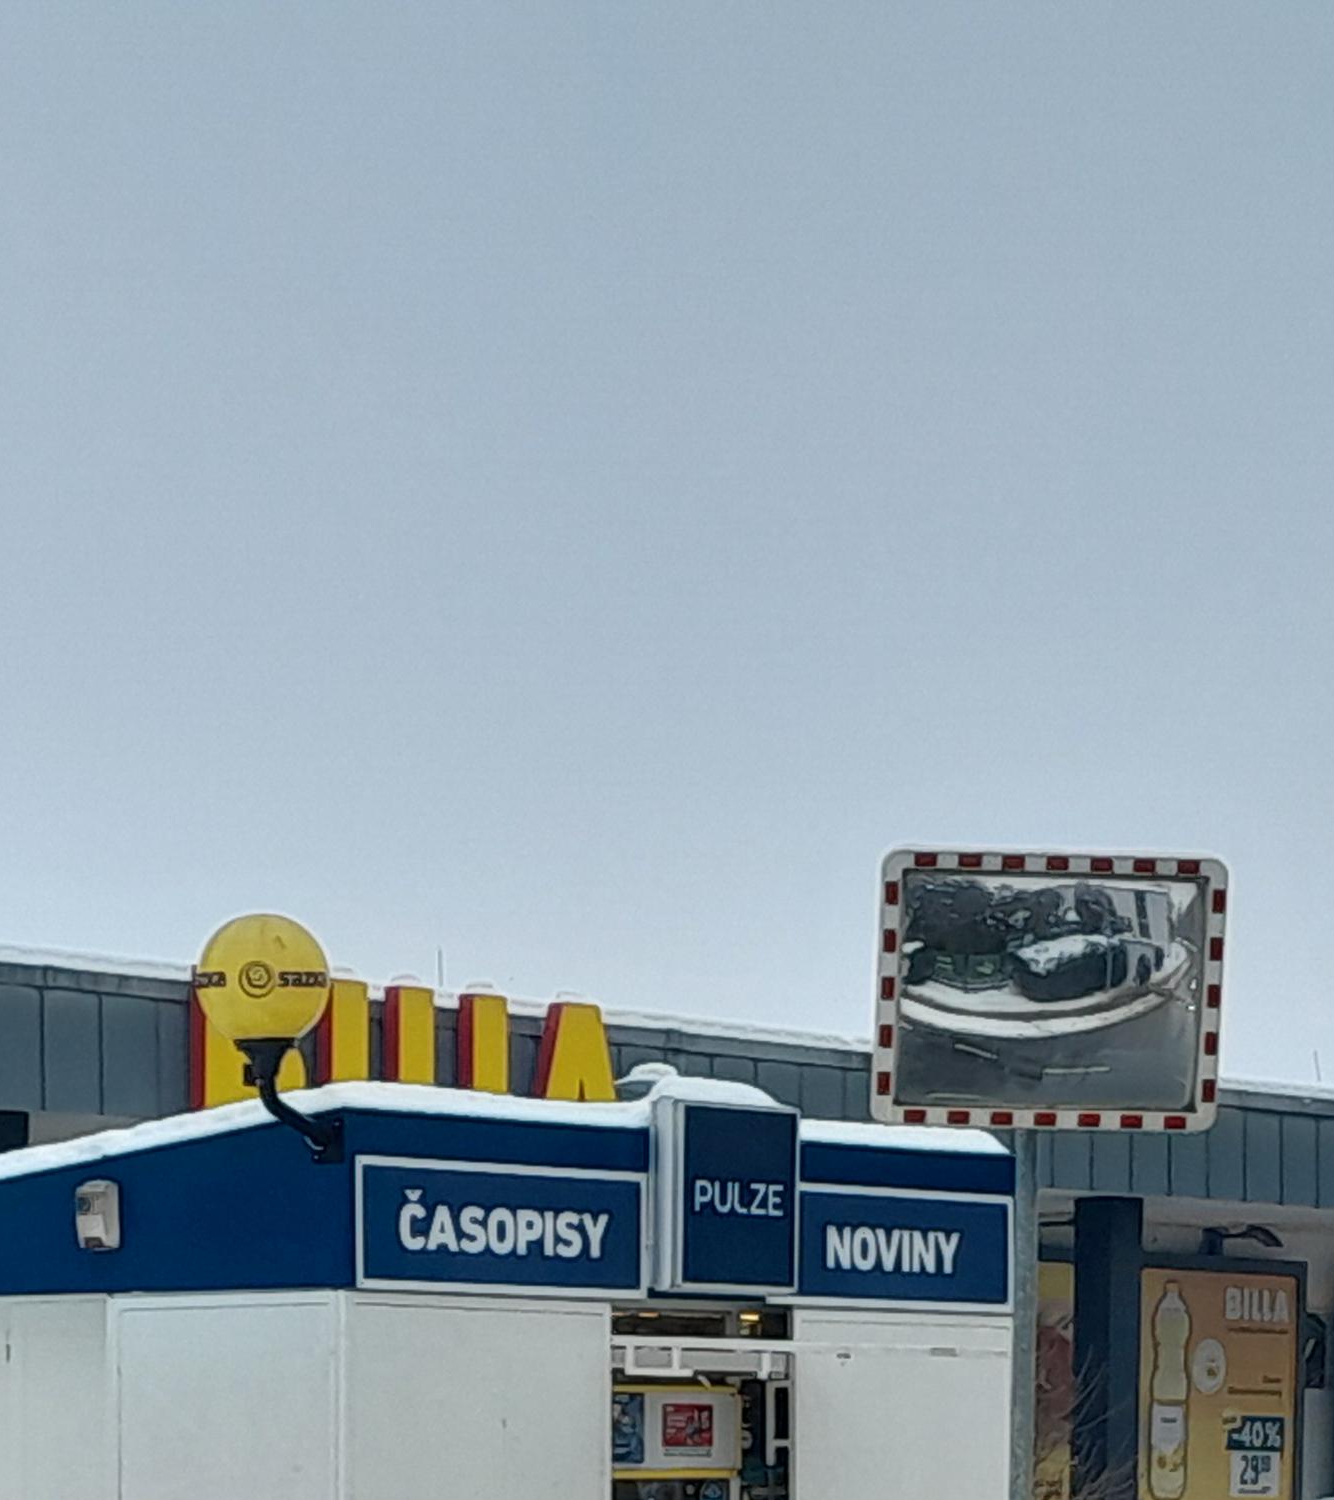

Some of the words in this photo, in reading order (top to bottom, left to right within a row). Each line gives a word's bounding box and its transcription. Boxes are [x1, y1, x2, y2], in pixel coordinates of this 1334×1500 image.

[695, 1180, 784, 1217] PULZE
[399, 1189, 609, 1258] ČASOPISY
[825, 1225, 960, 1274] NOVINY
[1225, 1286, 1289, 1322] BILLA
